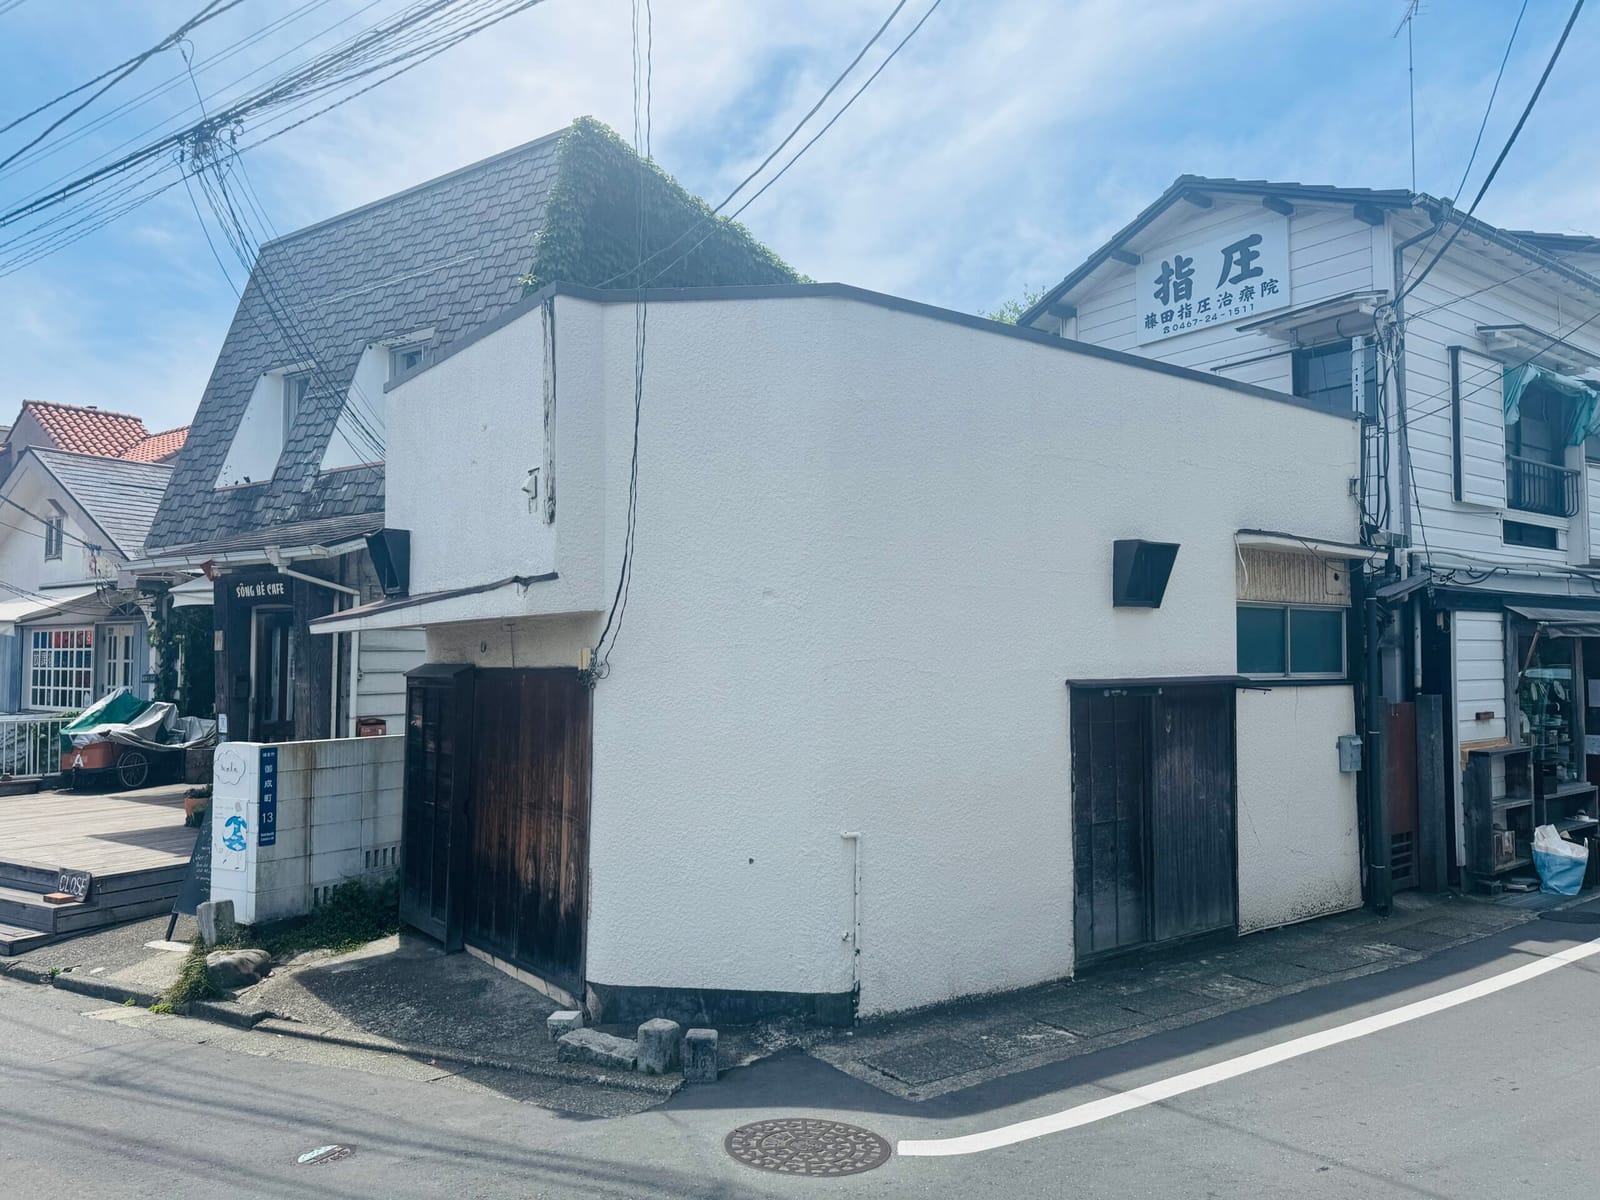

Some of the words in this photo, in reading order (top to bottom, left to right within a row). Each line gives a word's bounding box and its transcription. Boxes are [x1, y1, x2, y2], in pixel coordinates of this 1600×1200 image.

[1154, 233, 1264, 306] 指圧
[1143, 278, 1280, 329] 藤田指圧治療院
[266, 583, 285, 596] CAFE
[262, 811, 274, 824] 13
[58, 873, 88, 897] CLOSE
